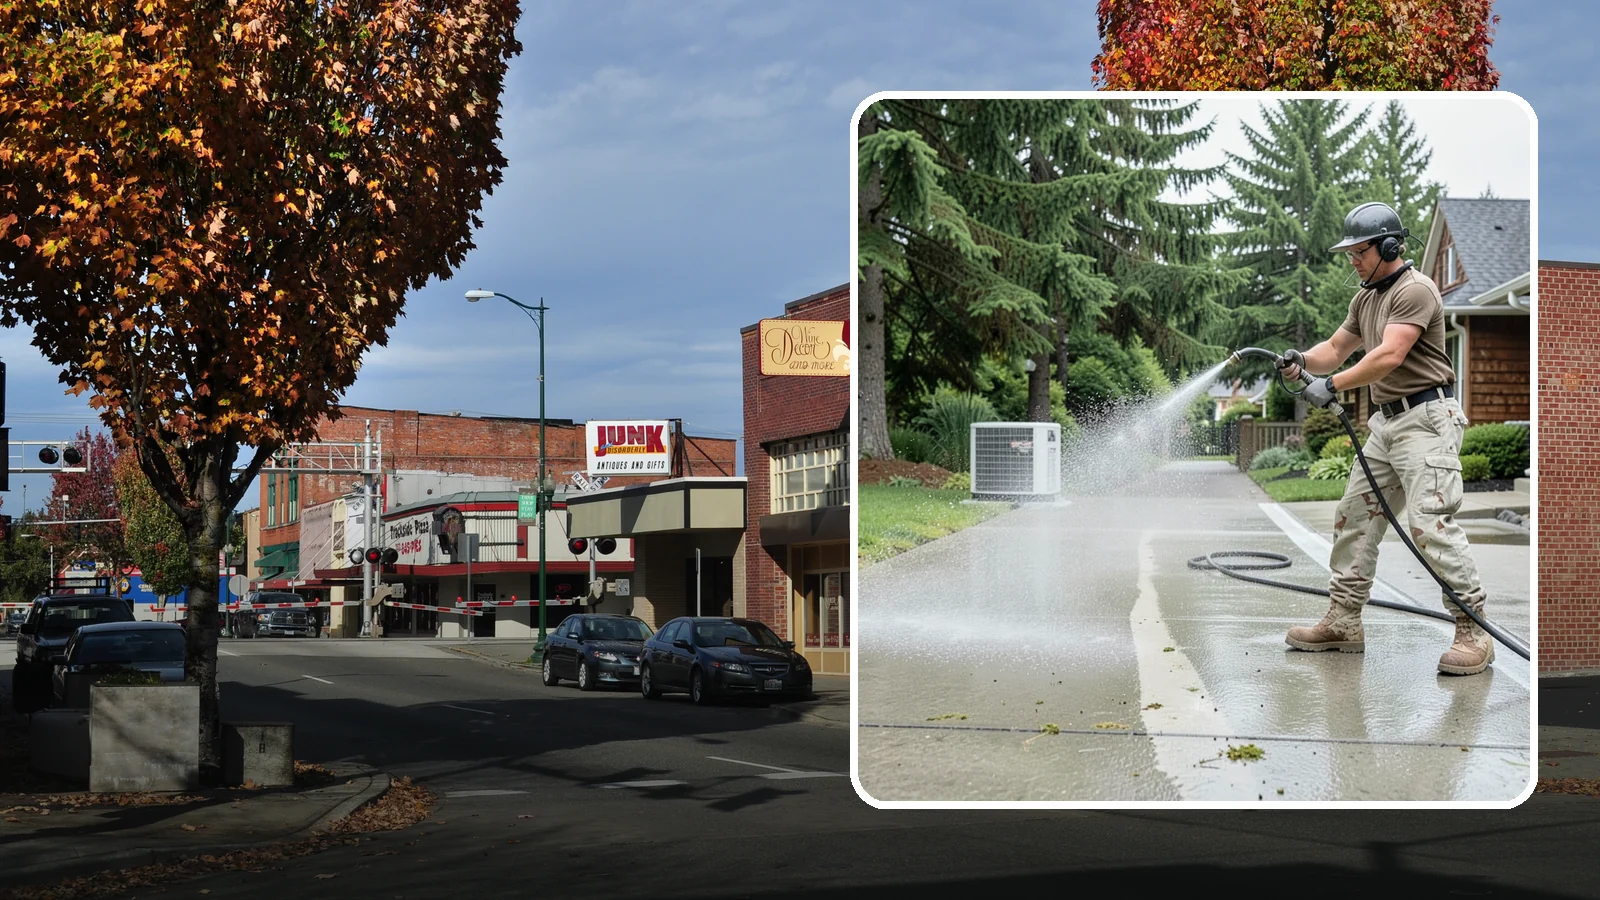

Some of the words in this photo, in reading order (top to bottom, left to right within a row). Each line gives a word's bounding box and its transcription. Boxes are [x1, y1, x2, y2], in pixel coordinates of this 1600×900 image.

[596, 425, 665, 457] JUNK
[607, 446, 646, 454] DISORDERLY
[597, 461, 628, 470] ANTIQUES
[631, 461, 644, 470] AND
[646, 460, 665, 469] GIFTS
[589, 476, 608, 492] SING
[390, 524, 413, 540] Trackside
[414, 519, 429, 535] Pizza
